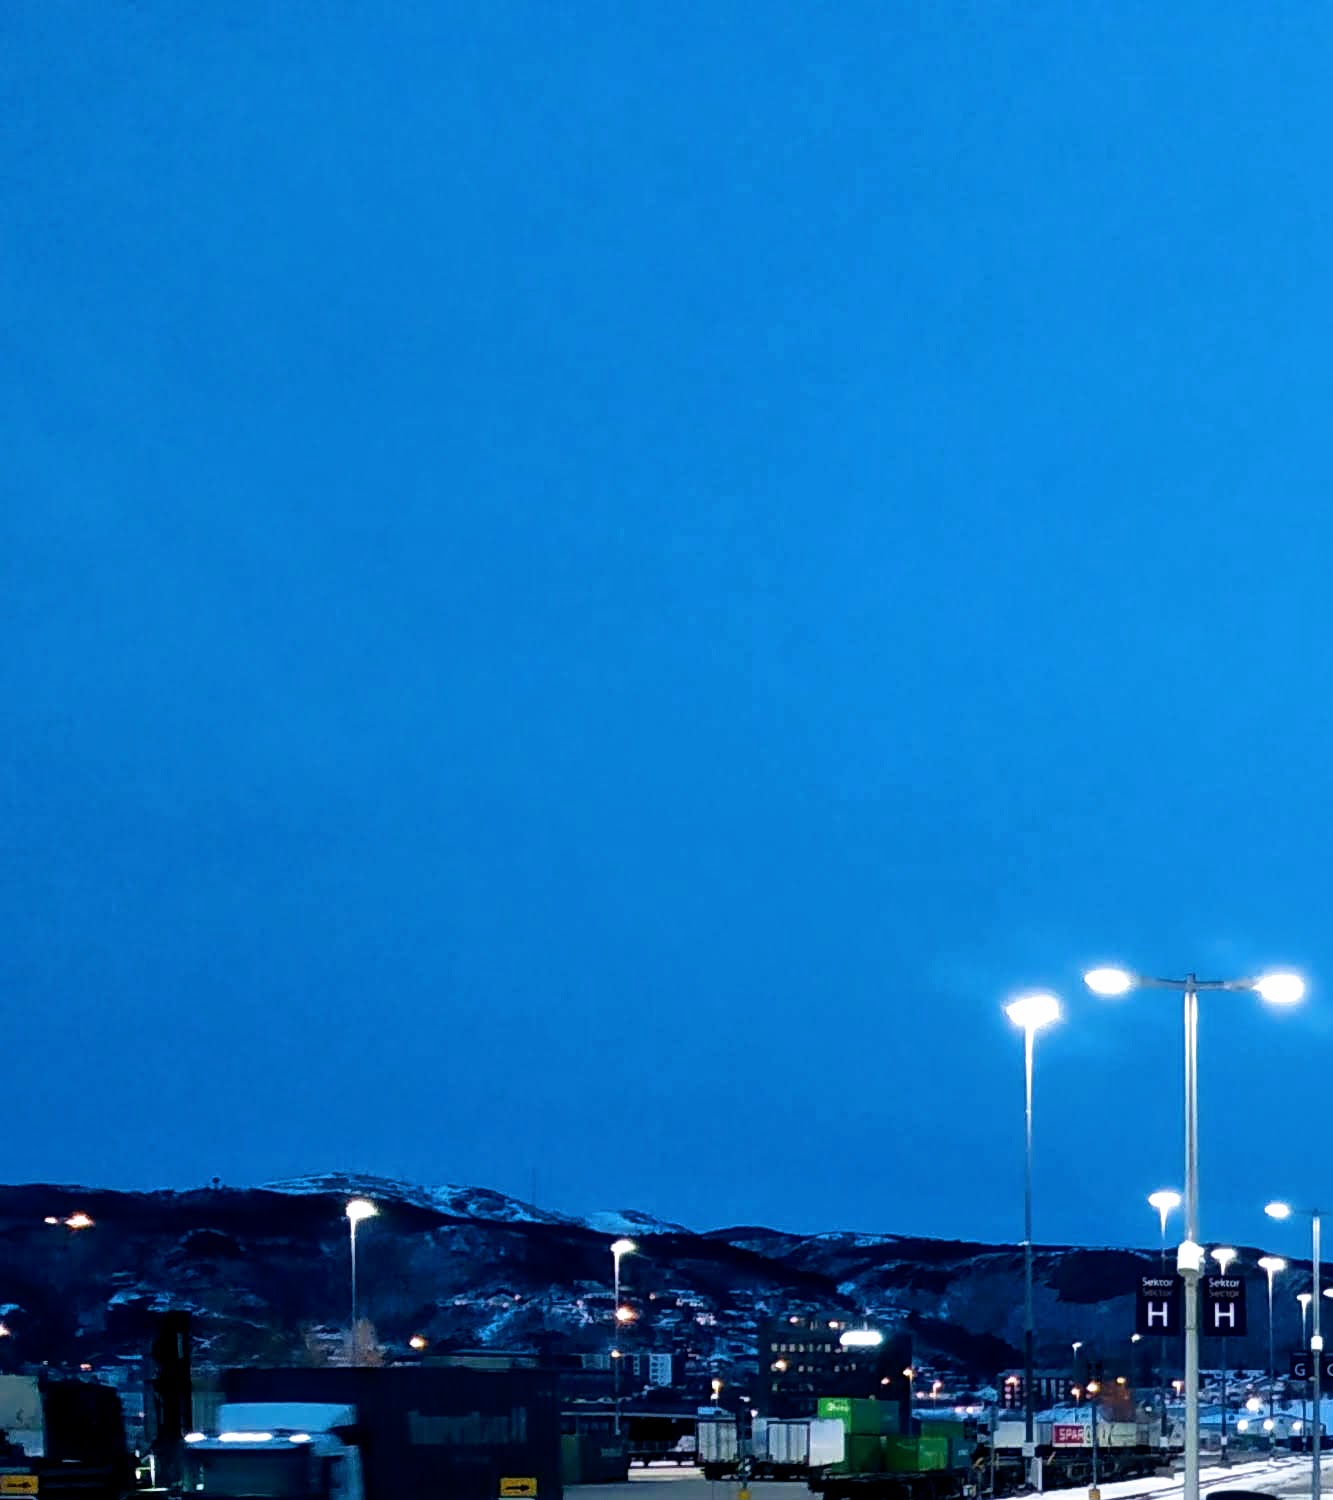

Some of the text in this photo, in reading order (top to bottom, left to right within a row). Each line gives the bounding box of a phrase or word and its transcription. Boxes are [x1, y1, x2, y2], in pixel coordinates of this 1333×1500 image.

[1142, 1277, 1173, 1287] Sektor
[1208, 1278, 1240, 1288] Sektor
[1147, 1301, 1168, 1327] H
[1214, 1302, 1235, 1327] H
[1294, 1363, 1306, 1377] G
